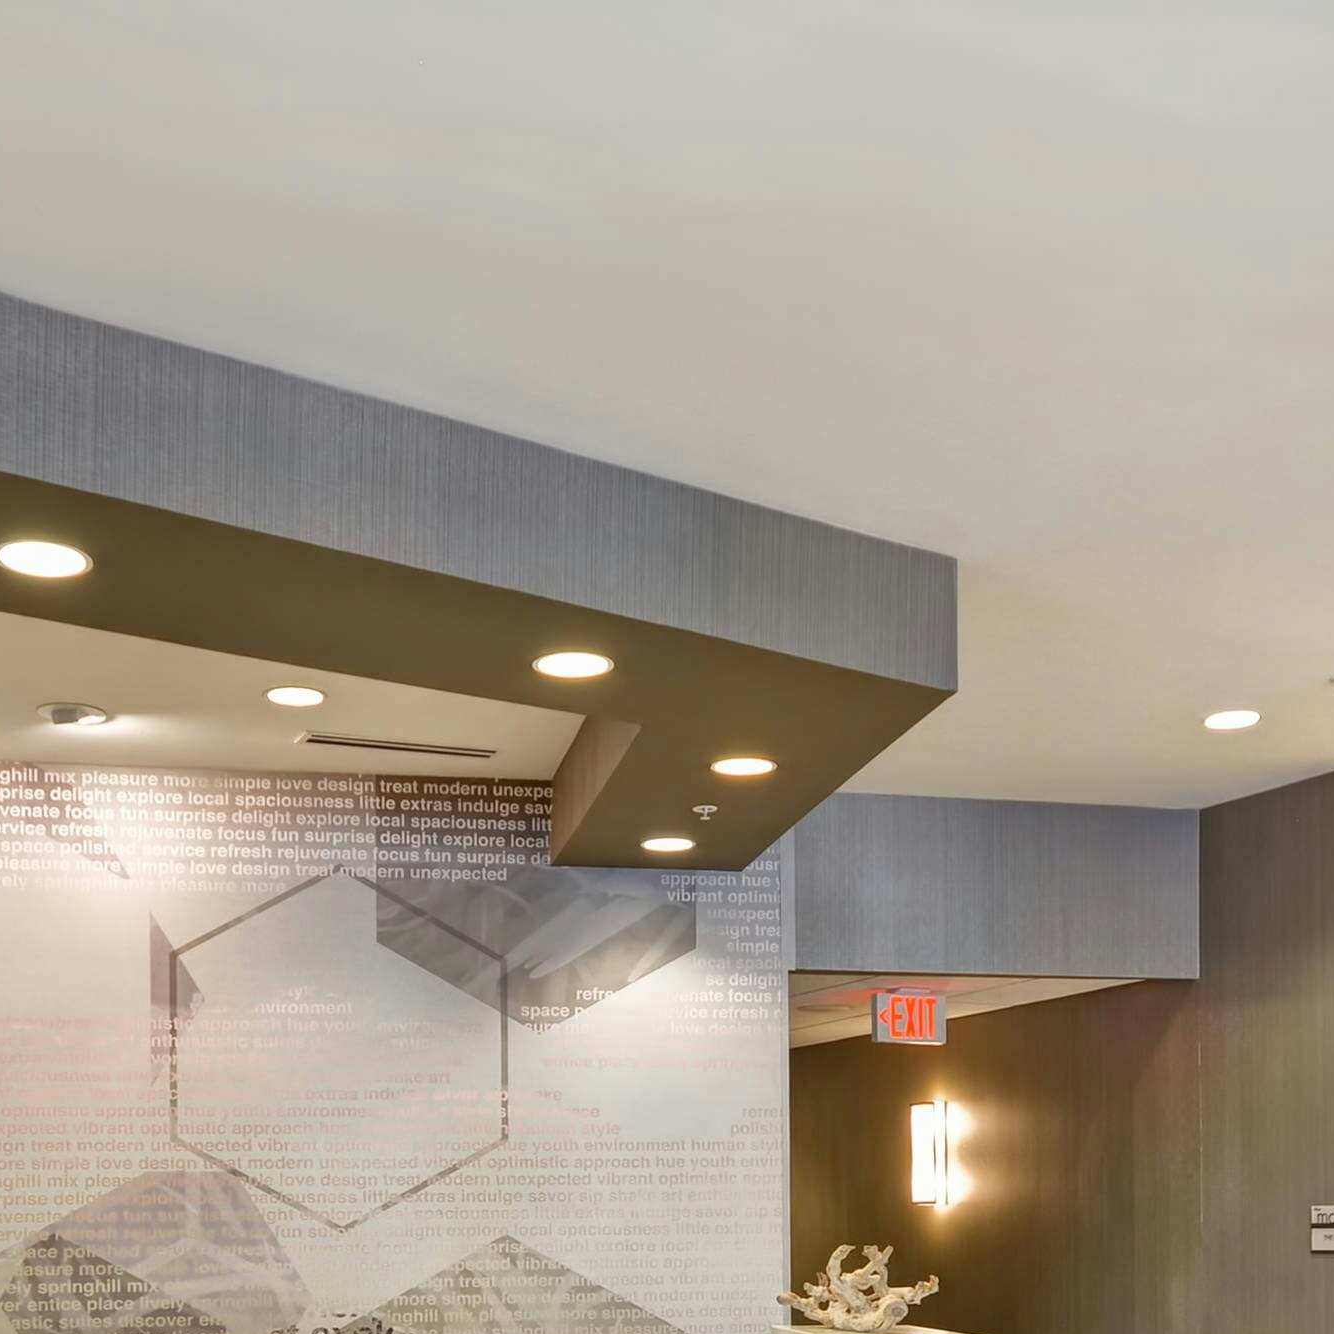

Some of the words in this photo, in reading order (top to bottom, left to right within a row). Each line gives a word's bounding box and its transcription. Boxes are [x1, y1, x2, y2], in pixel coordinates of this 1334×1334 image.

[45, 768, 75, 783] mix
[82, 768, 158, 790] pleasure
[164, 775, 208, 787] more
[216, 772, 271, 793] simple
[277, 774, 312, 790] love
[317, 775, 374, 796] design
[379, 778, 417, 794] treat
[423, 779, 487, 796] modern
[50, 784, 111, 805] delight
[117, 786, 183, 807] explore
[188, 788, 229, 805] local
[235, 791, 354, 812] spaciousness
[360, 794, 395, 810] little
[401, 796, 452, 812] extras
[457, 797, 519, 817] indulge
[65, 803, 113, 819] focus
[120, 804, 148, 820] fun
[155, 806, 227, 826] surprise
[232, 807, 291, 828] delight
[296, 809, 360, 830] explore
[366, 810, 405, 827] local
[411, 813, 526, 834] spaciousness
[52, 821, 114, 837] refresh
[121, 823, 212, 844] rejuvenate
[218, 825, 266, 841] focus
[271, 826, 299, 842] fun
[305, 828, 375, 848] surprise
[381, 829, 438, 850] delight
[443, 831, 505, 851] explore
[511, 832, 549, 849] local
[1, 840, 55, 857] space
[61, 838, 136, 859] polished
[142, 841, 205, 856] service
[211, 841, 272, 858] refresh
[277, 844, 367, 864] rejuvenate
[373, 845, 419, 862] focus
[425, 847, 452, 863] fun
[457, 848, 525, 868] surprise
[75, 859, 121, 872] more
[127, 857, 185, 877] simple
[191, 858, 227, 874] love
[232, 859, 290, 880] design
[296, 862, 334, 877] treat
[340, 862, 404, 878] modern
[410, 863, 507, 885] unexpected
[661, 871, 736, 889] approach
[742, 872, 771, 887] hue
[667, 886, 723, 902] vibrant
[727, 937, 778, 956] simple
[728, 987, 771, 1001] focus
[521, 1006, 569, 1020] space
[713, 1003, 769, 1018] refresh
[890, 996, 938, 1039] EXIT
[487, 1155, 567, 1172] optimistic
[575, 1154, 649, 1172] approach
[47, 1173, 78, 1188] mix
[38, 1278, 121, 1297] springhill
[127, 1279, 159, 1293] mix
[27, 1297, 81, 1311] entice
[87, 1295, 133, 1314] place
[124, 1312, 194, 1327] discover
